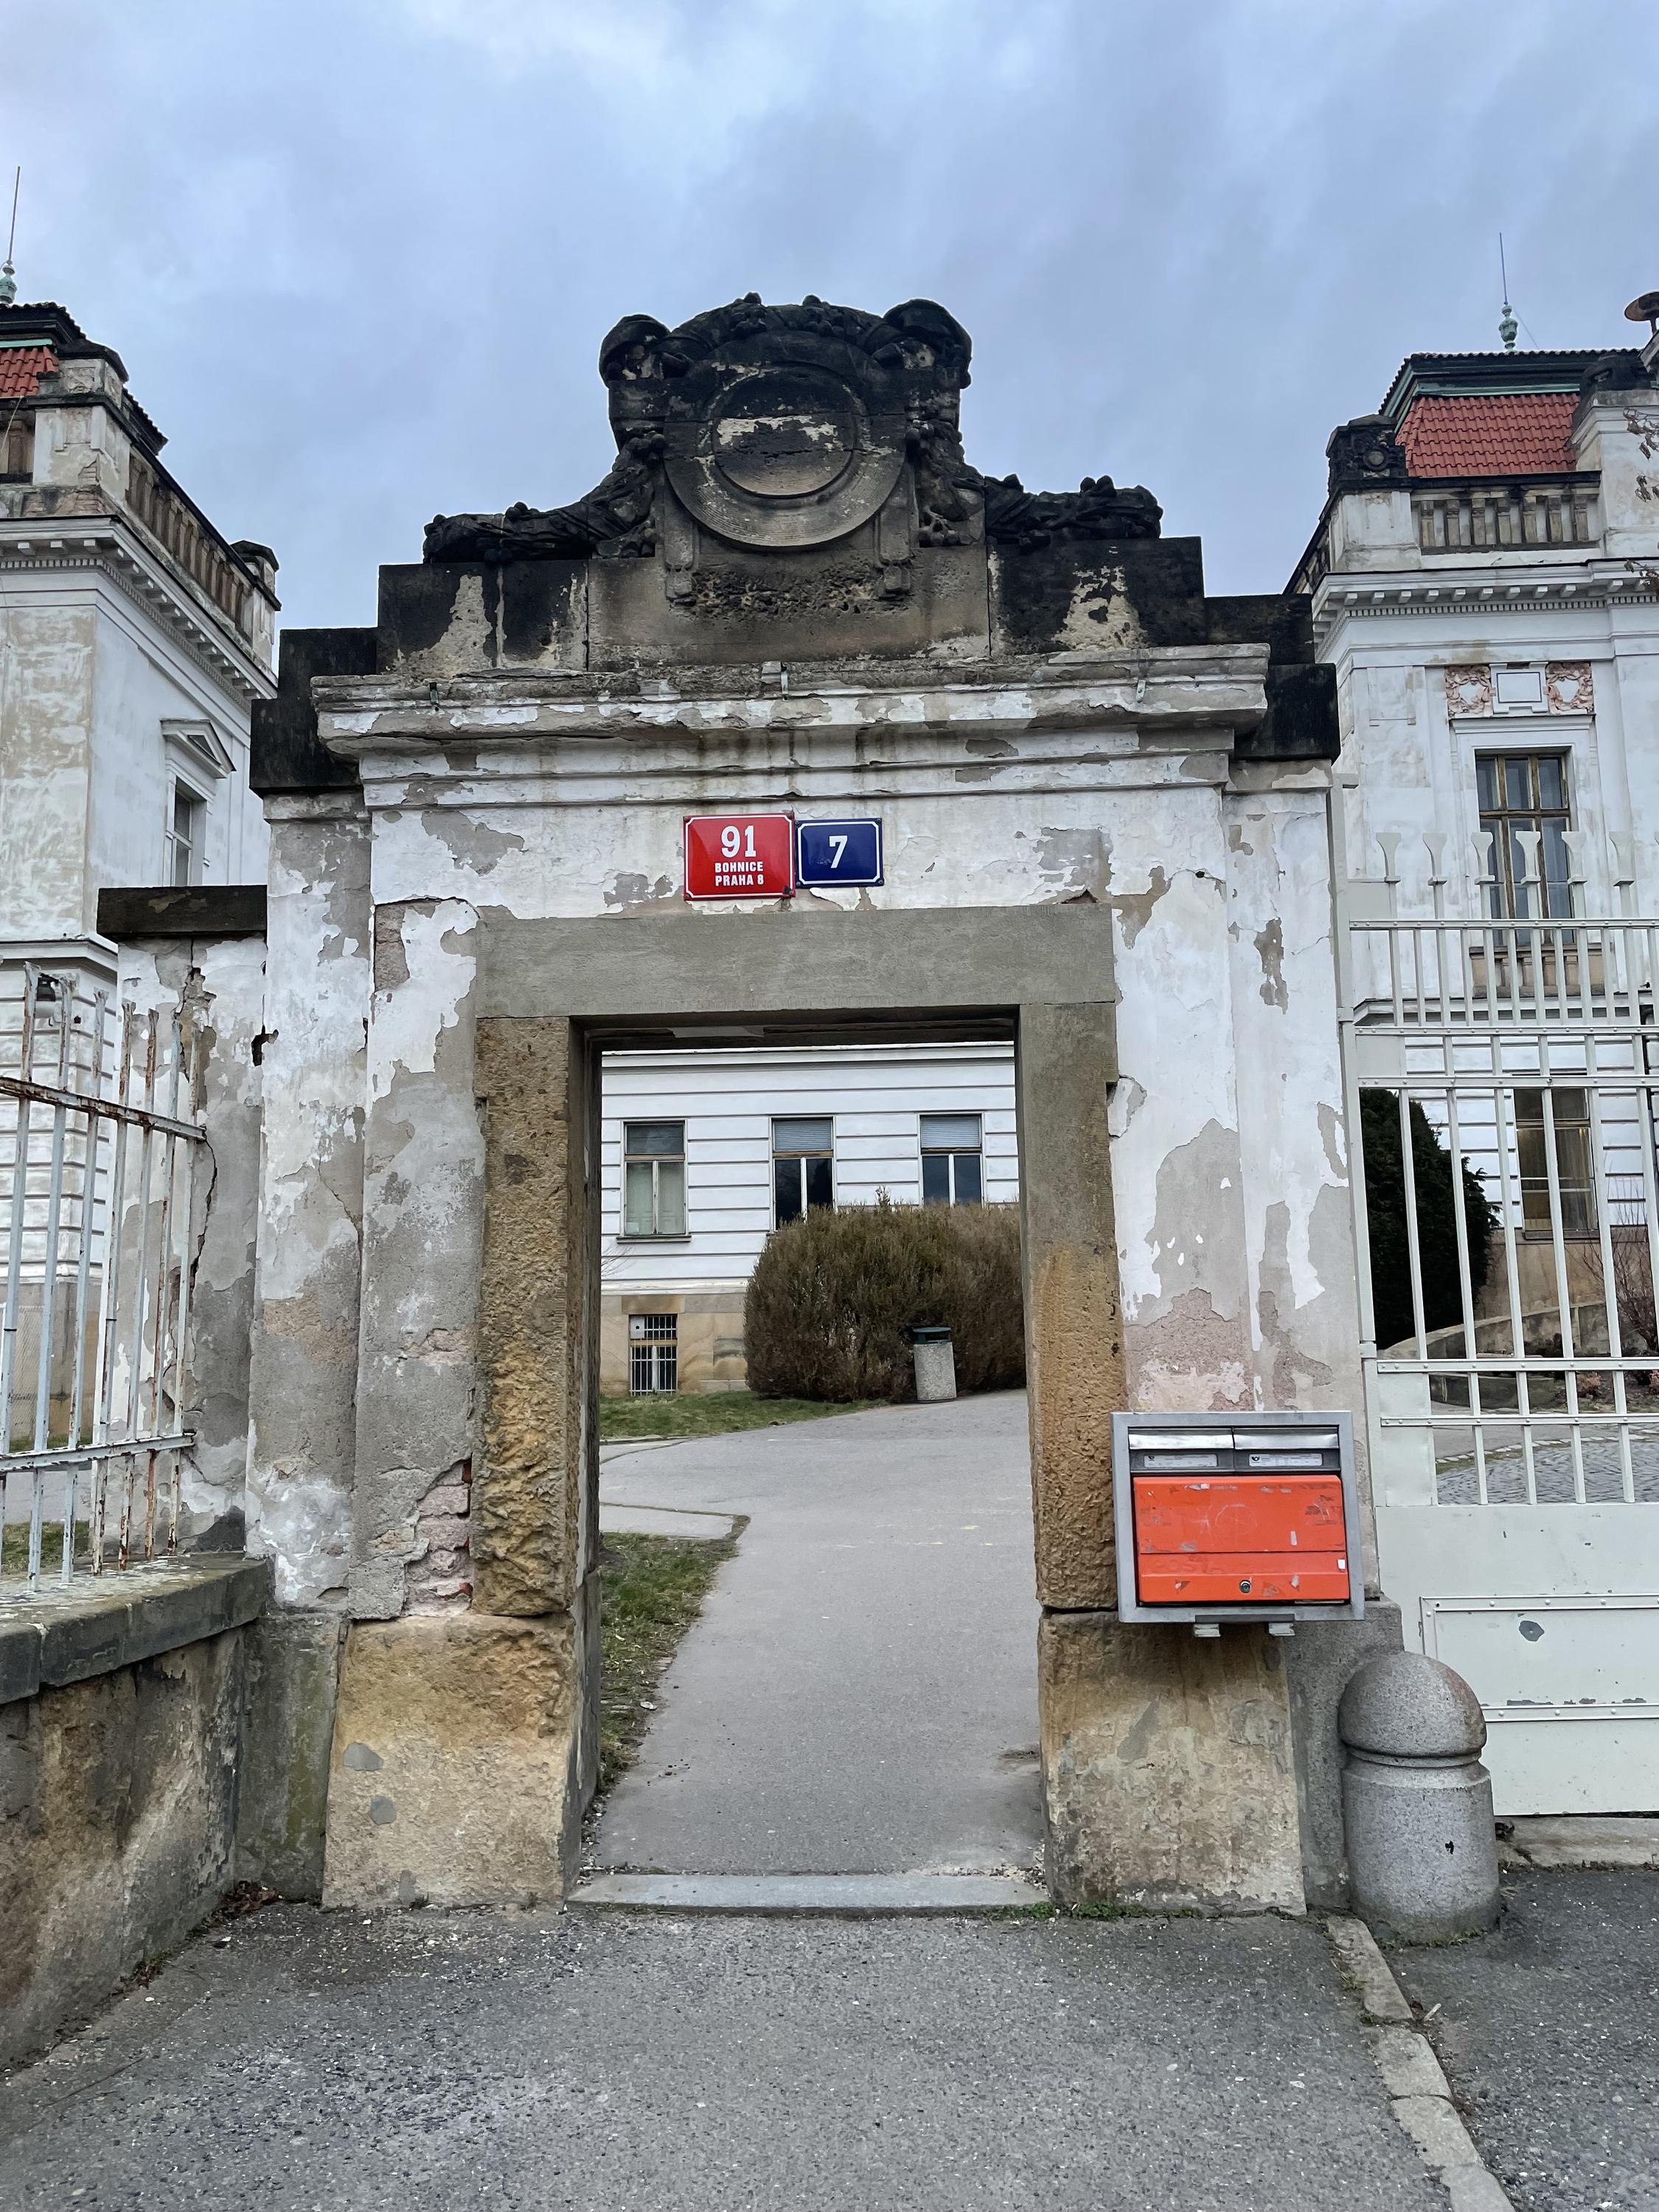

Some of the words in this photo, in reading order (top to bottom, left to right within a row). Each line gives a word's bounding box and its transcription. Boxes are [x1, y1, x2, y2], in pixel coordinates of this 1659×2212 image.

[721, 825, 757, 858] 91
[829, 835, 848, 869] 7
[714, 860, 764, 873] BOHNICE
[715, 874, 753, 886] PRAHA
[757, 874, 764, 885] 8
